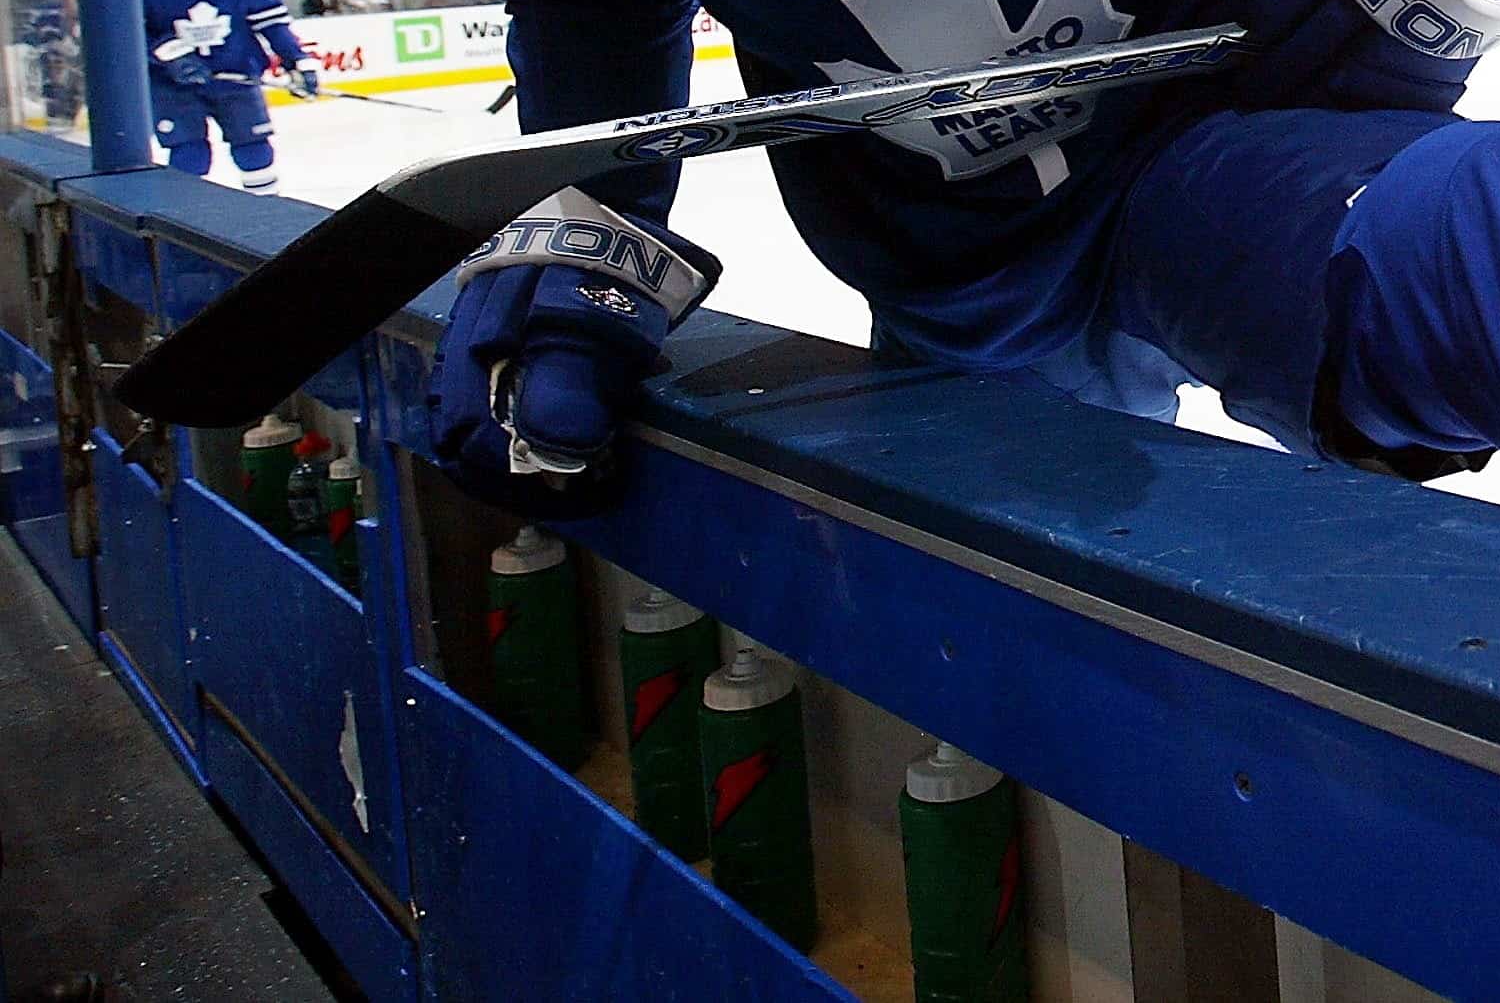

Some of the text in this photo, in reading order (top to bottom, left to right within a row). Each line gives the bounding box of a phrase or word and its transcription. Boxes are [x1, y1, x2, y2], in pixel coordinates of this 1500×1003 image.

[397, 24, 441, 55] TD
[613, 86, 843, 133] EASTON
[955, 95, 1084, 158] LEAFS
[462, 217, 672, 294] STON
